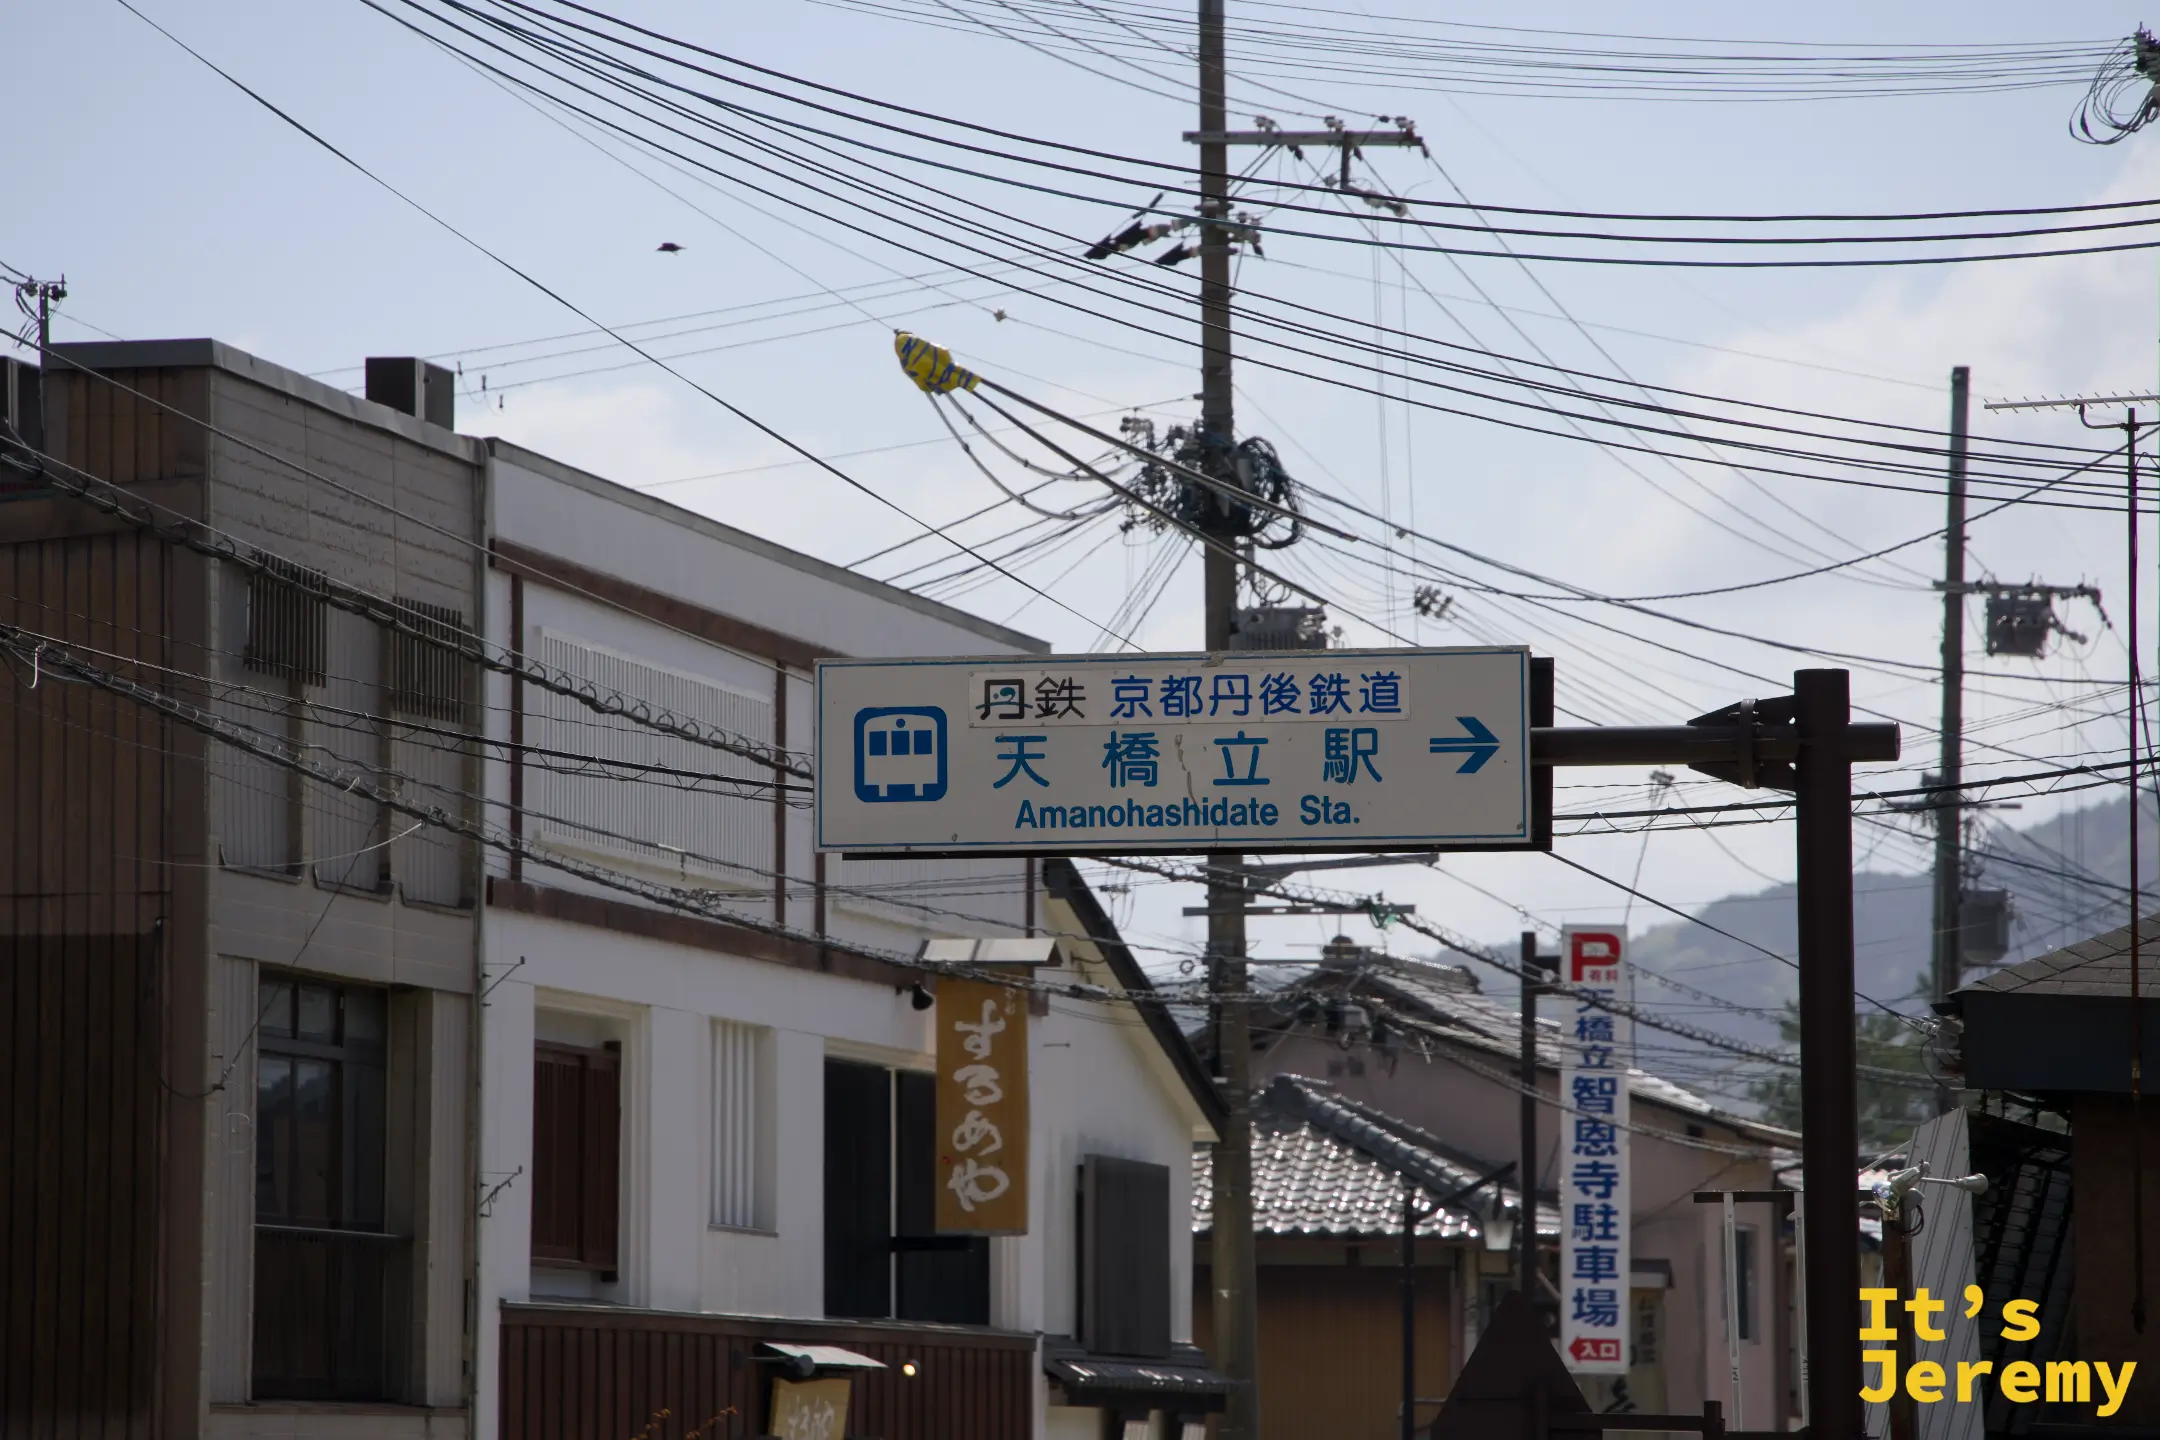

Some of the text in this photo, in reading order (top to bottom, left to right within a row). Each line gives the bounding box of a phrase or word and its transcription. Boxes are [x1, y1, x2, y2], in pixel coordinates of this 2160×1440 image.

[974, 670, 1402, 720] 丹鉄 京都丹後鉄道
[992, 727, 1383, 789] 天橋立駅
[1014, 794, 1361, 829] Amanohashidate Sta.
[1571, 932, 1621, 982] P
[947, 999, 1010, 1212] するめや
[1579, 1341, 1617, 1358] 入口
